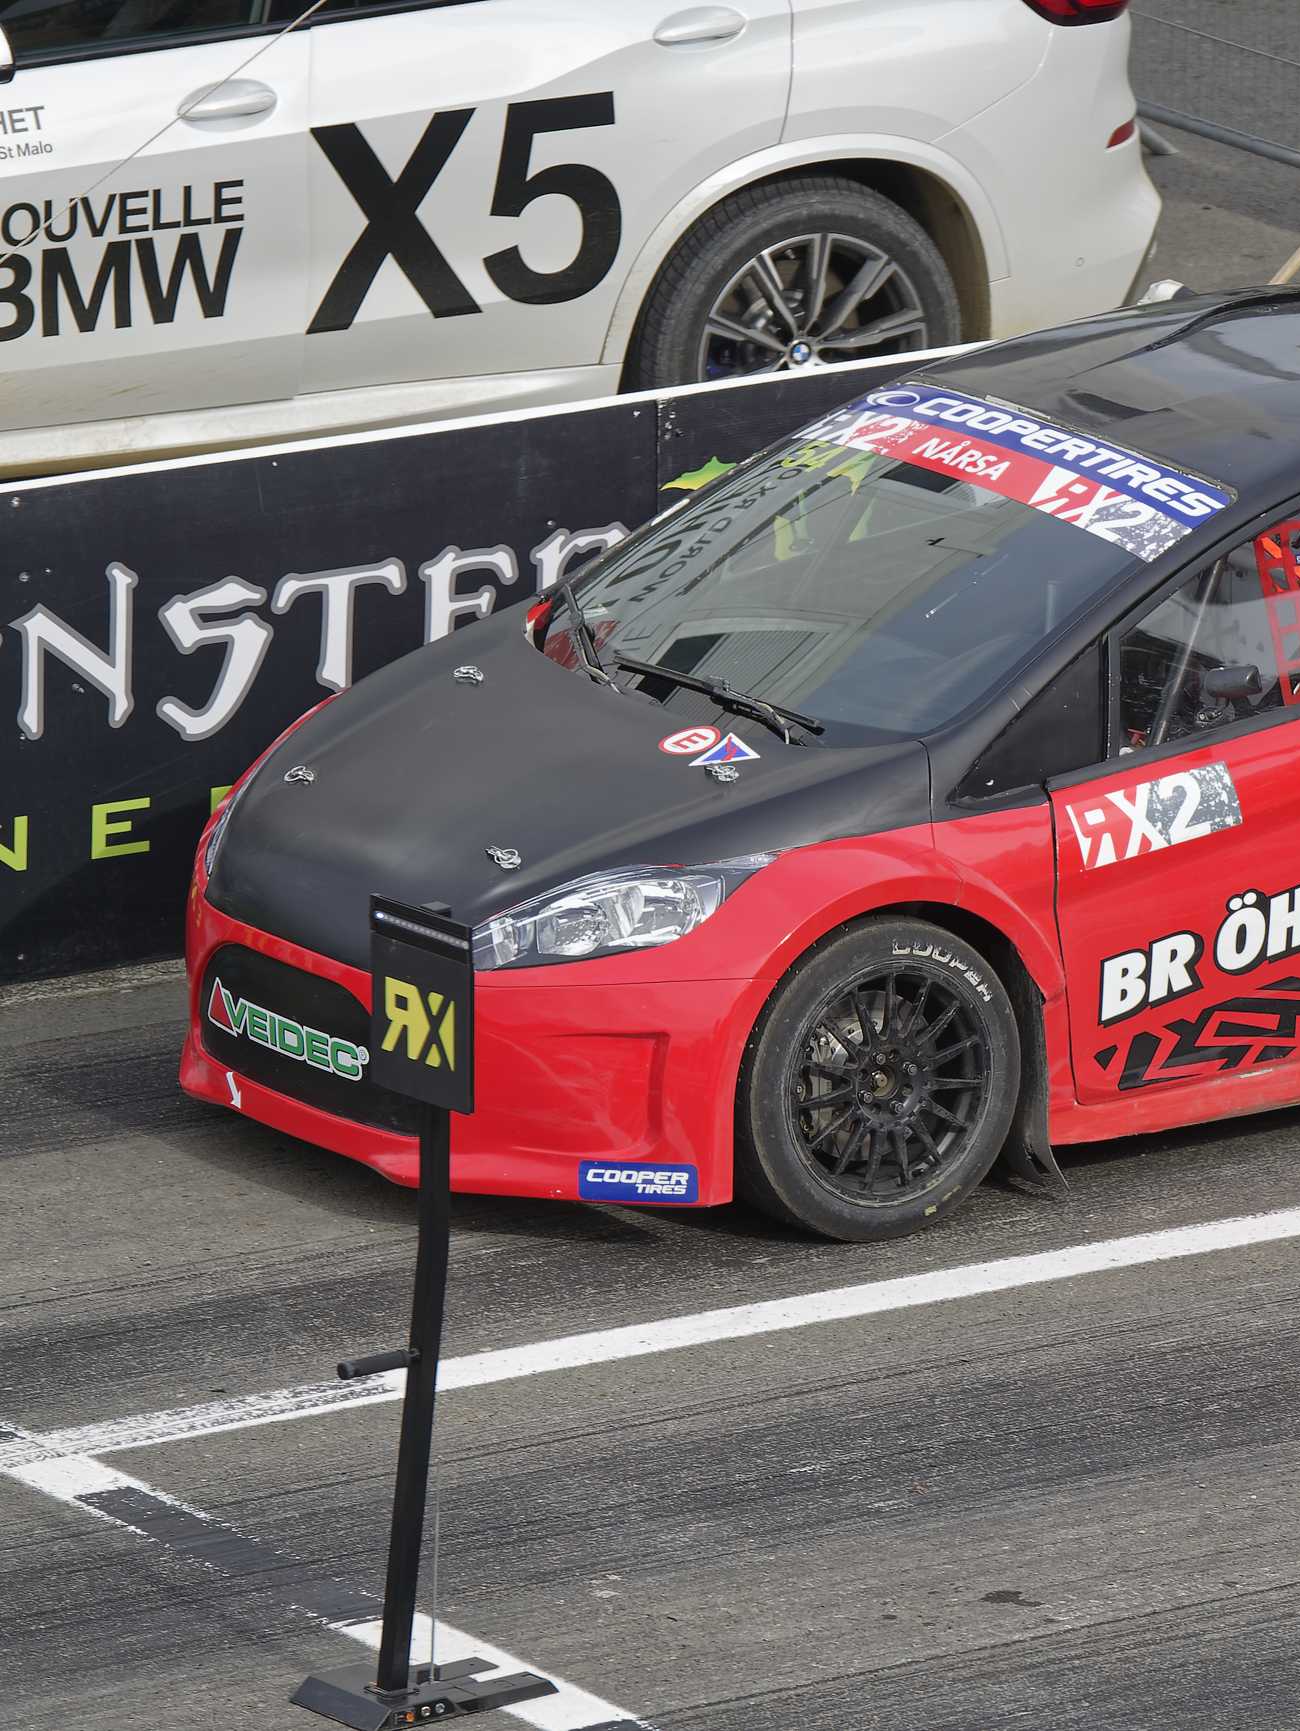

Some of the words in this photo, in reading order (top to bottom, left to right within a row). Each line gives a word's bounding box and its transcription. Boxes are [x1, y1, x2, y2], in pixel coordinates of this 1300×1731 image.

[17, 140, 53, 158] Malo
[305, 90, 622, 334] X5
[0, 227, 244, 342] BMW
[911, 436, 1013, 482] NÅRSA
[1100, 931, 1203, 1026] BR
[220, 984, 363, 1081] VEIDEC
[586, 1168, 689, 1186] COOPER
[634, 1183, 688, 1195] TIRES
